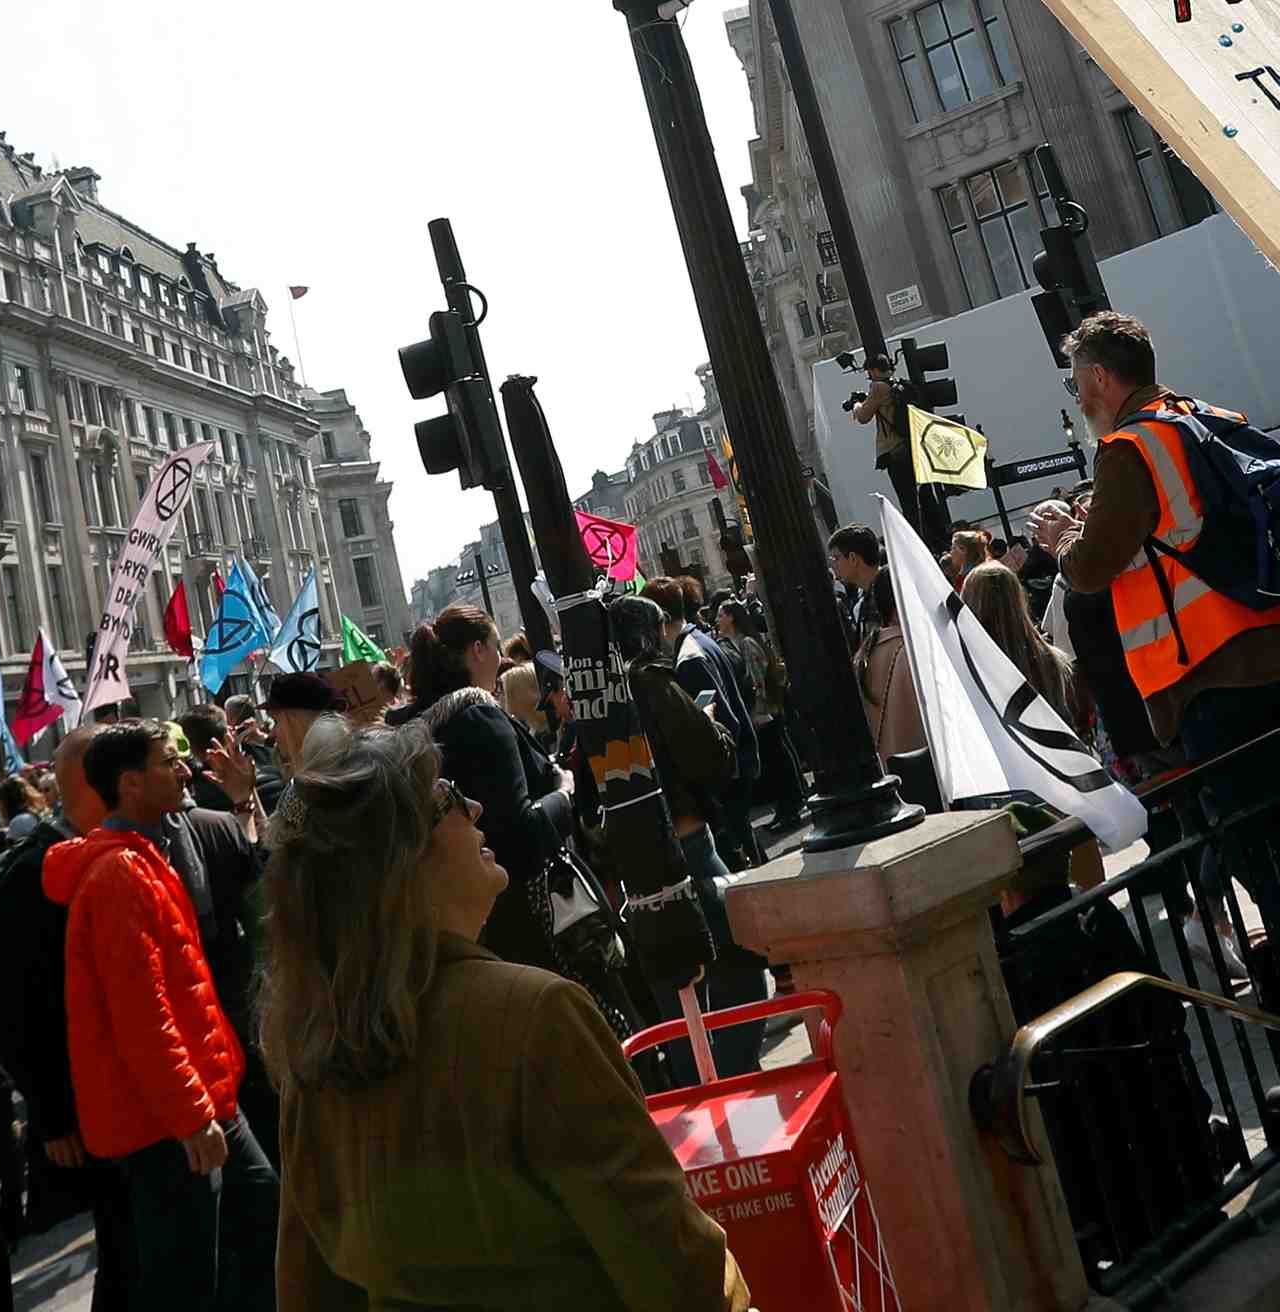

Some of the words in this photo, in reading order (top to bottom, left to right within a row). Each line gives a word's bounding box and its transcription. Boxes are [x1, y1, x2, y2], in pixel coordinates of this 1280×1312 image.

[683, 1170, 720, 1201] AKE
[725, 1158, 772, 1192] ONE
[727, 1200, 763, 1221] TAKE
[765, 1191, 796, 1214] ONE
